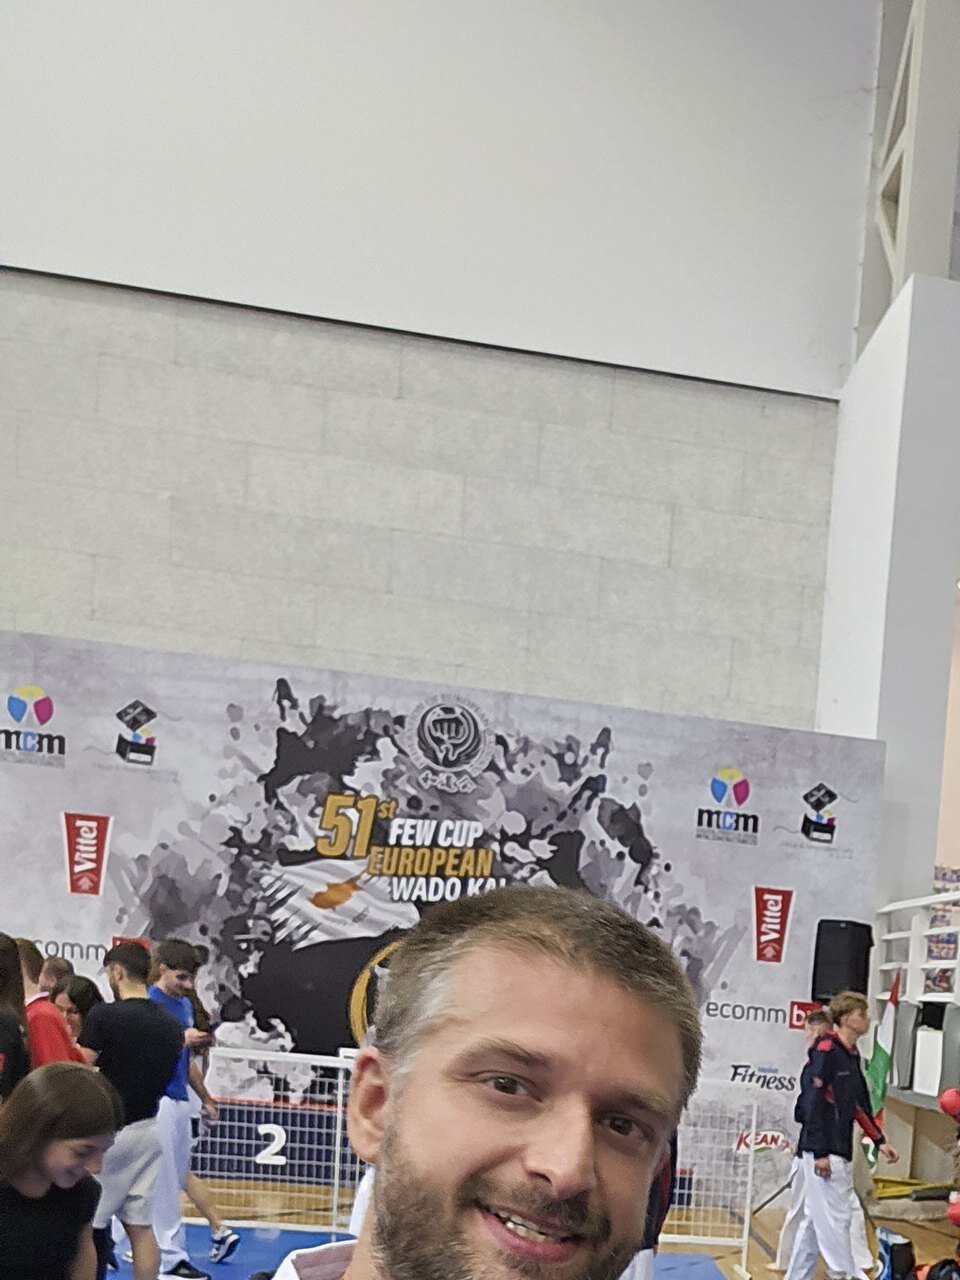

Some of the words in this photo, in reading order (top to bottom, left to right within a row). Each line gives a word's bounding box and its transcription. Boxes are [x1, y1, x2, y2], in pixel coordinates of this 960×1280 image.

[73, 819, 99, 874] Vittel
[388, 817, 437, 847] FEW
[437, 819, 484, 848] CUP
[368, 846, 494, 877] EUROPEAN
[391, 875, 462, 902] WADO
[760, 893, 784, 943] Vittel
[730, 1064, 798, 1092] Fitness
[254, 1123, 288, 1166] 2
